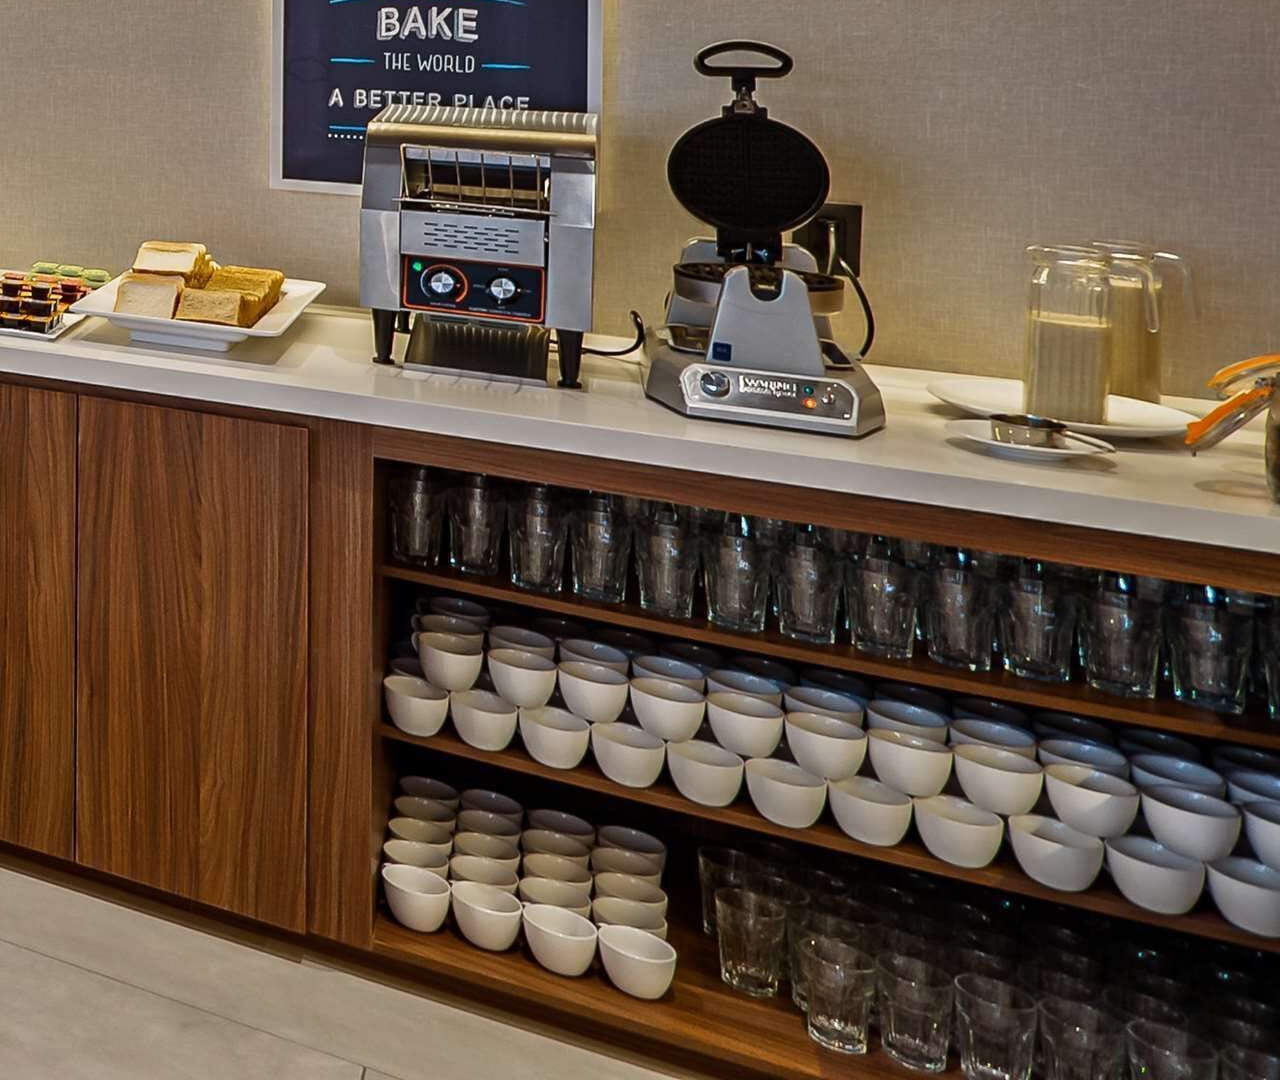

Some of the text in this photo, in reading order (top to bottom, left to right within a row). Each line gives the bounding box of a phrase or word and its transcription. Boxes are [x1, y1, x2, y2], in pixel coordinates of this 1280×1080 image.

[376, 6, 479, 43] BAKE
[383, 52, 476, 74] THE WORLD
[328, 87, 344, 108] A
[353, 88, 442, 109] BETTER
